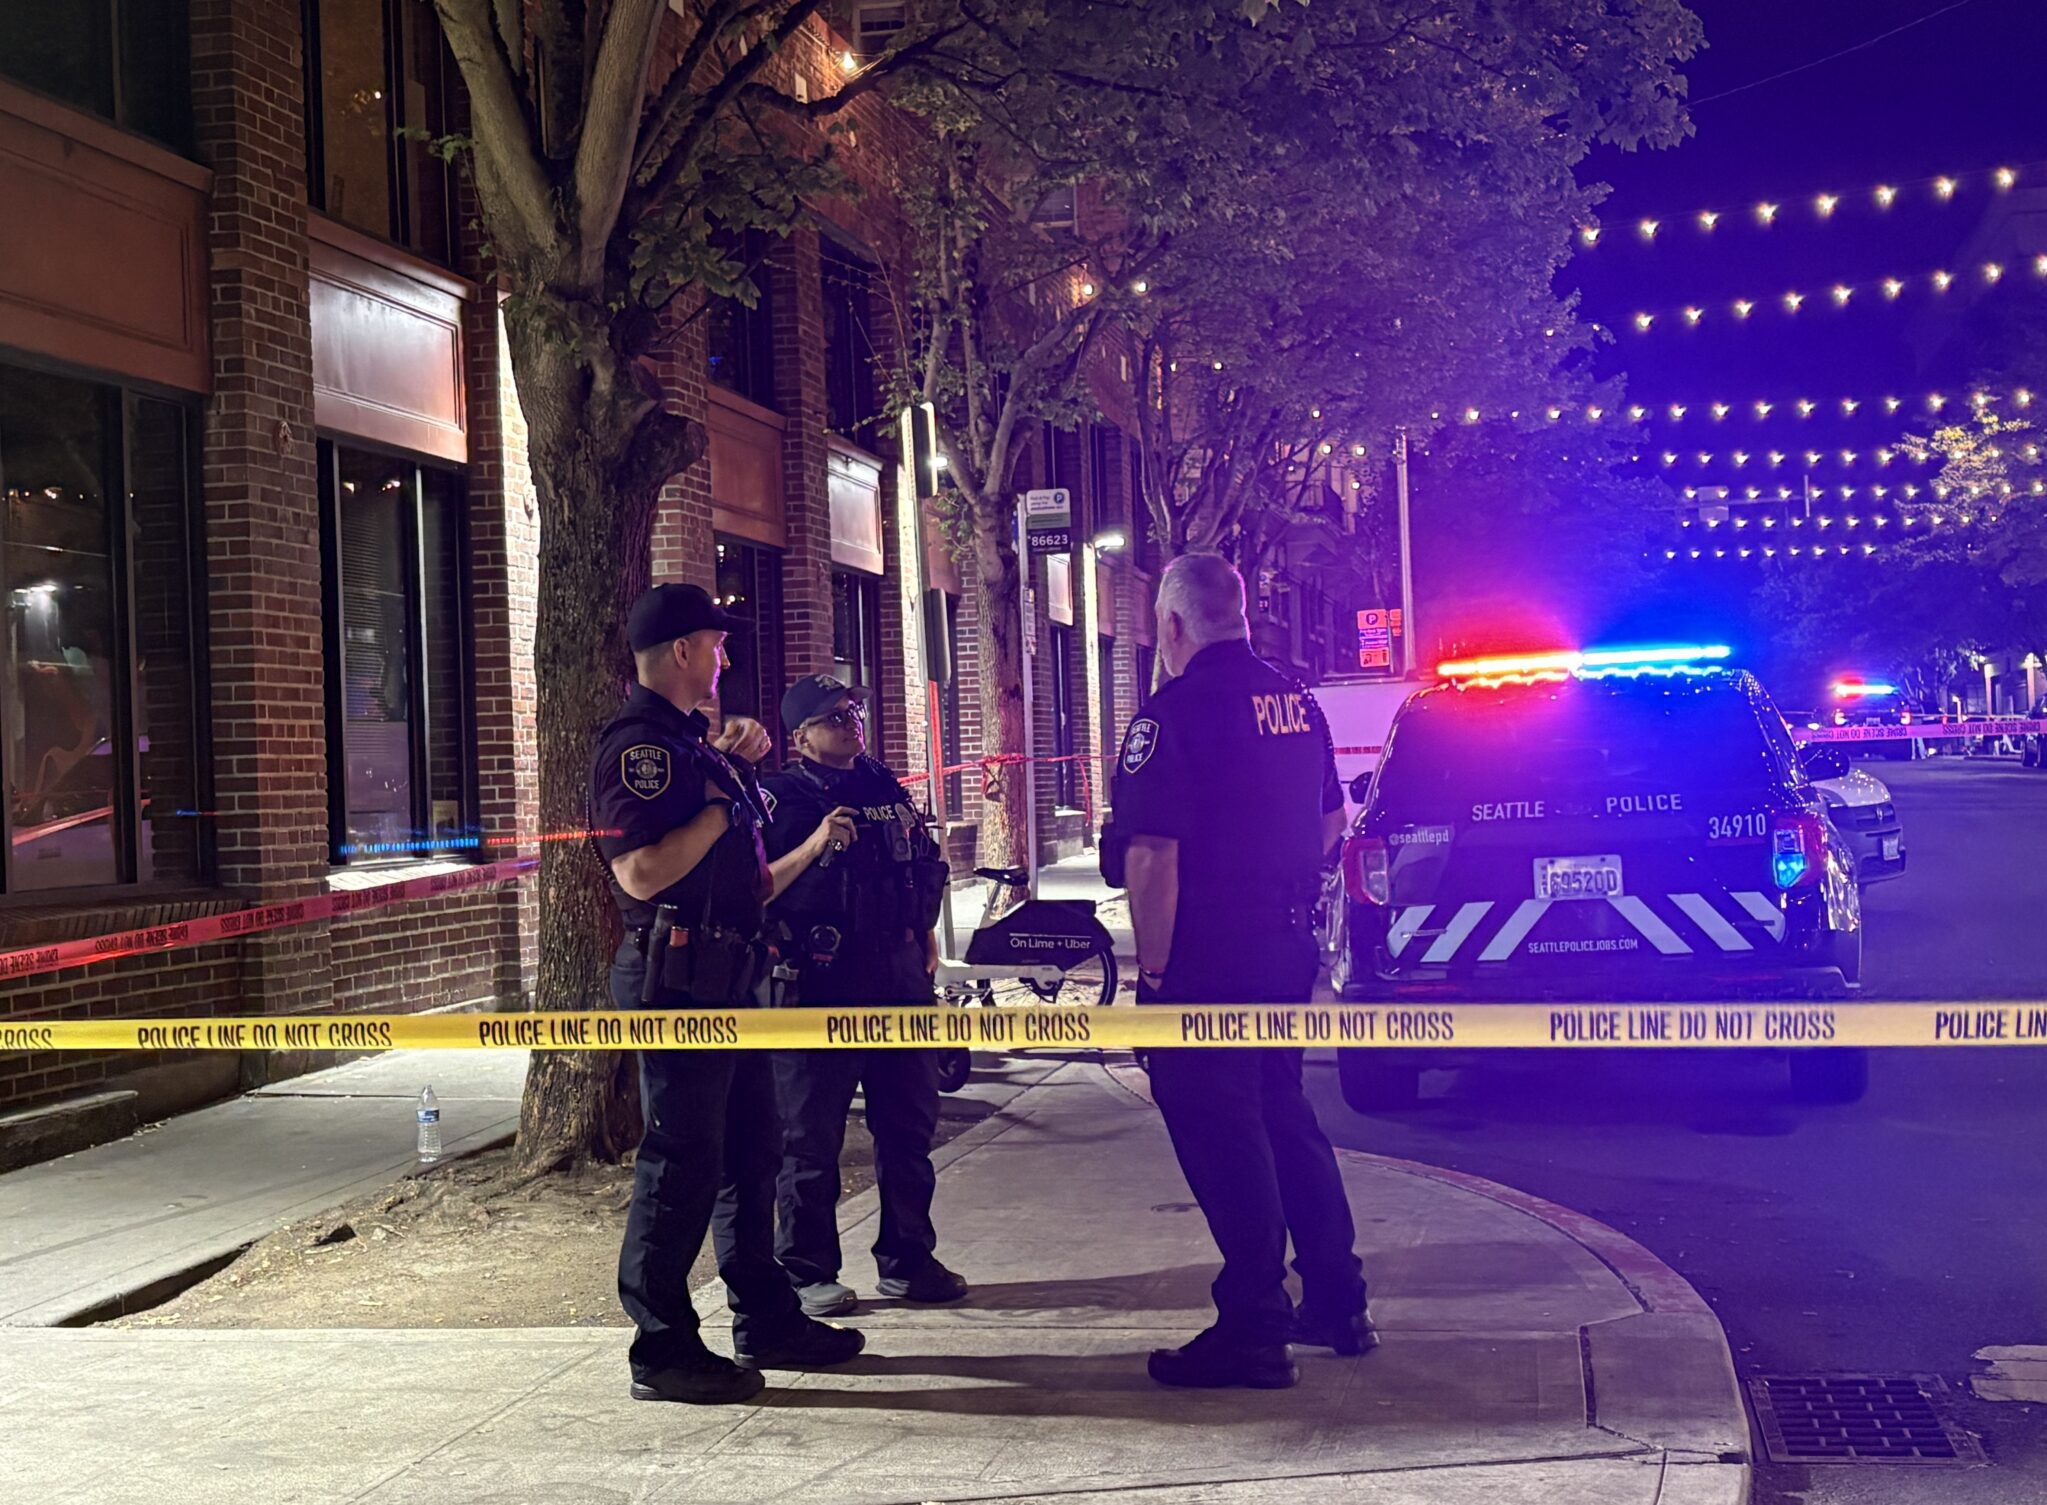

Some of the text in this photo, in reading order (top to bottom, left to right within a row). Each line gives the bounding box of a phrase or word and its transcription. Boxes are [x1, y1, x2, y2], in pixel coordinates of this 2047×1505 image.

[1031, 534, 1068, 546] 86623
[1252, 694, 1311, 735] POLICE
[1850, 729, 1861, 738] DO
[630, 749, 662, 760] SEATTLE
[634, 780, 660, 789] POLICE
[862, 805, 895, 821] POLICE
[1472, 794, 1682, 821] SEATTLE POLICE
[1389, 829, 1449, 845] @seattlepd
[1708, 813, 1766, 839] 34910
[1010, 937, 1026, 948] On
[1028, 938, 1055, 949] Lime
[1065, 939, 1091, 949] Uber
[138, 1022, 393, 1049] POLICE LINE DO NOT CROSS
[479, 1016, 738, 1047] POLICE LINE DO NOT CROSS
[827, 1012, 1091, 1043] POLICE LINE DO NOT CROSS
[1181, 1010, 1454, 1042] POLICE LINE DO NOT CROSS
[1550, 1009, 1835, 1041] POLICE LINE DO NOT CROSS
[1935, 1009, 2008, 1040] POLICE
[0, 1028, 54, 1049] ROSS
